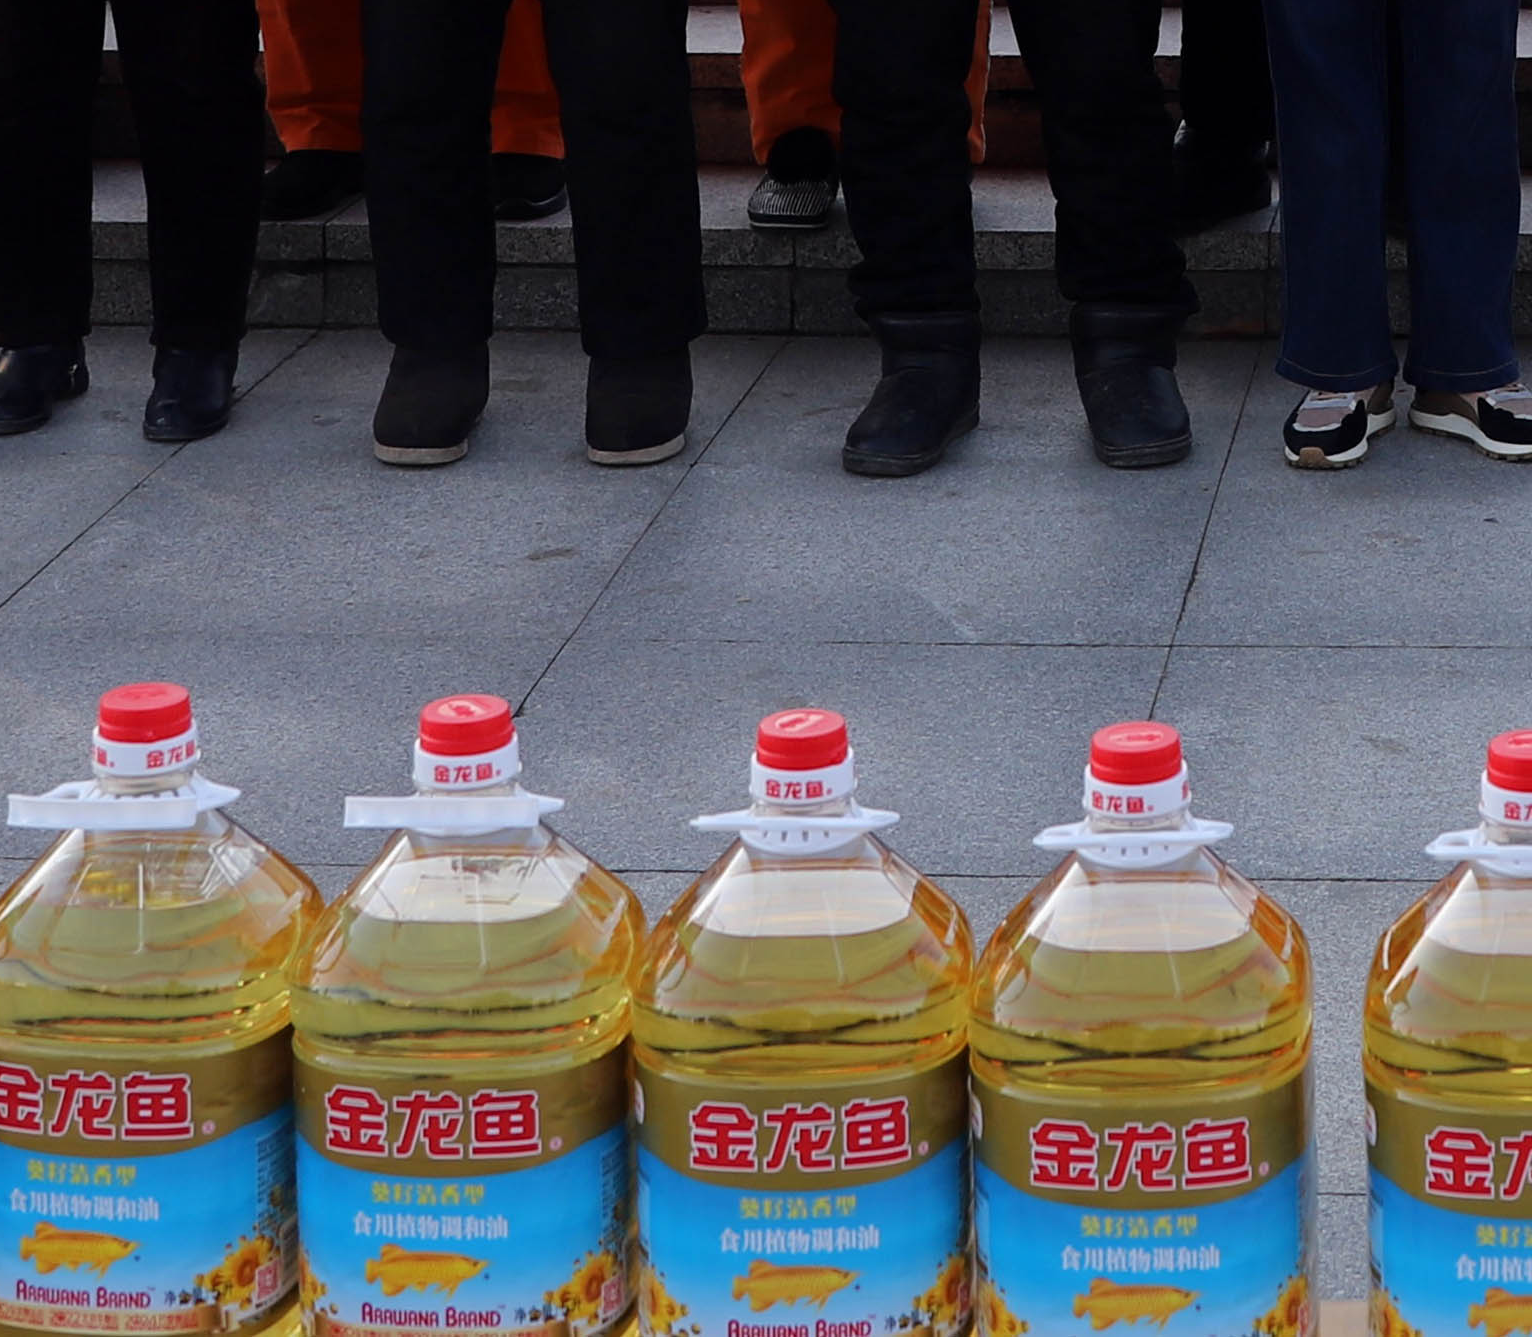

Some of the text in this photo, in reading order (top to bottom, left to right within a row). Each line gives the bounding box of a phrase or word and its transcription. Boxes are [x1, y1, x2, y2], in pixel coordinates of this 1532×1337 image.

[433, 761, 494, 784] 金龙鱼
[765, 778, 824, 800] 金龙鱼
[1091, 788, 1146, 814] 金龙鱼
[324, 1085, 542, 1159] 金龙鱼
[689, 1098, 912, 1172] 金龙鱼
[1029, 1118, 1253, 1191] 金龙鱼
[9, 1187, 160, 1222] 食用植物调和油
[353, 1210, 509, 1240] 食用植物调和油
[720, 1223, 880, 1255] 食用植物调和油
[1060, 1243, 1221, 1273] 食用植物调和油
[96, 1284, 152, 1309] BRAND
[445, 1305, 502, 1328] BRAND
